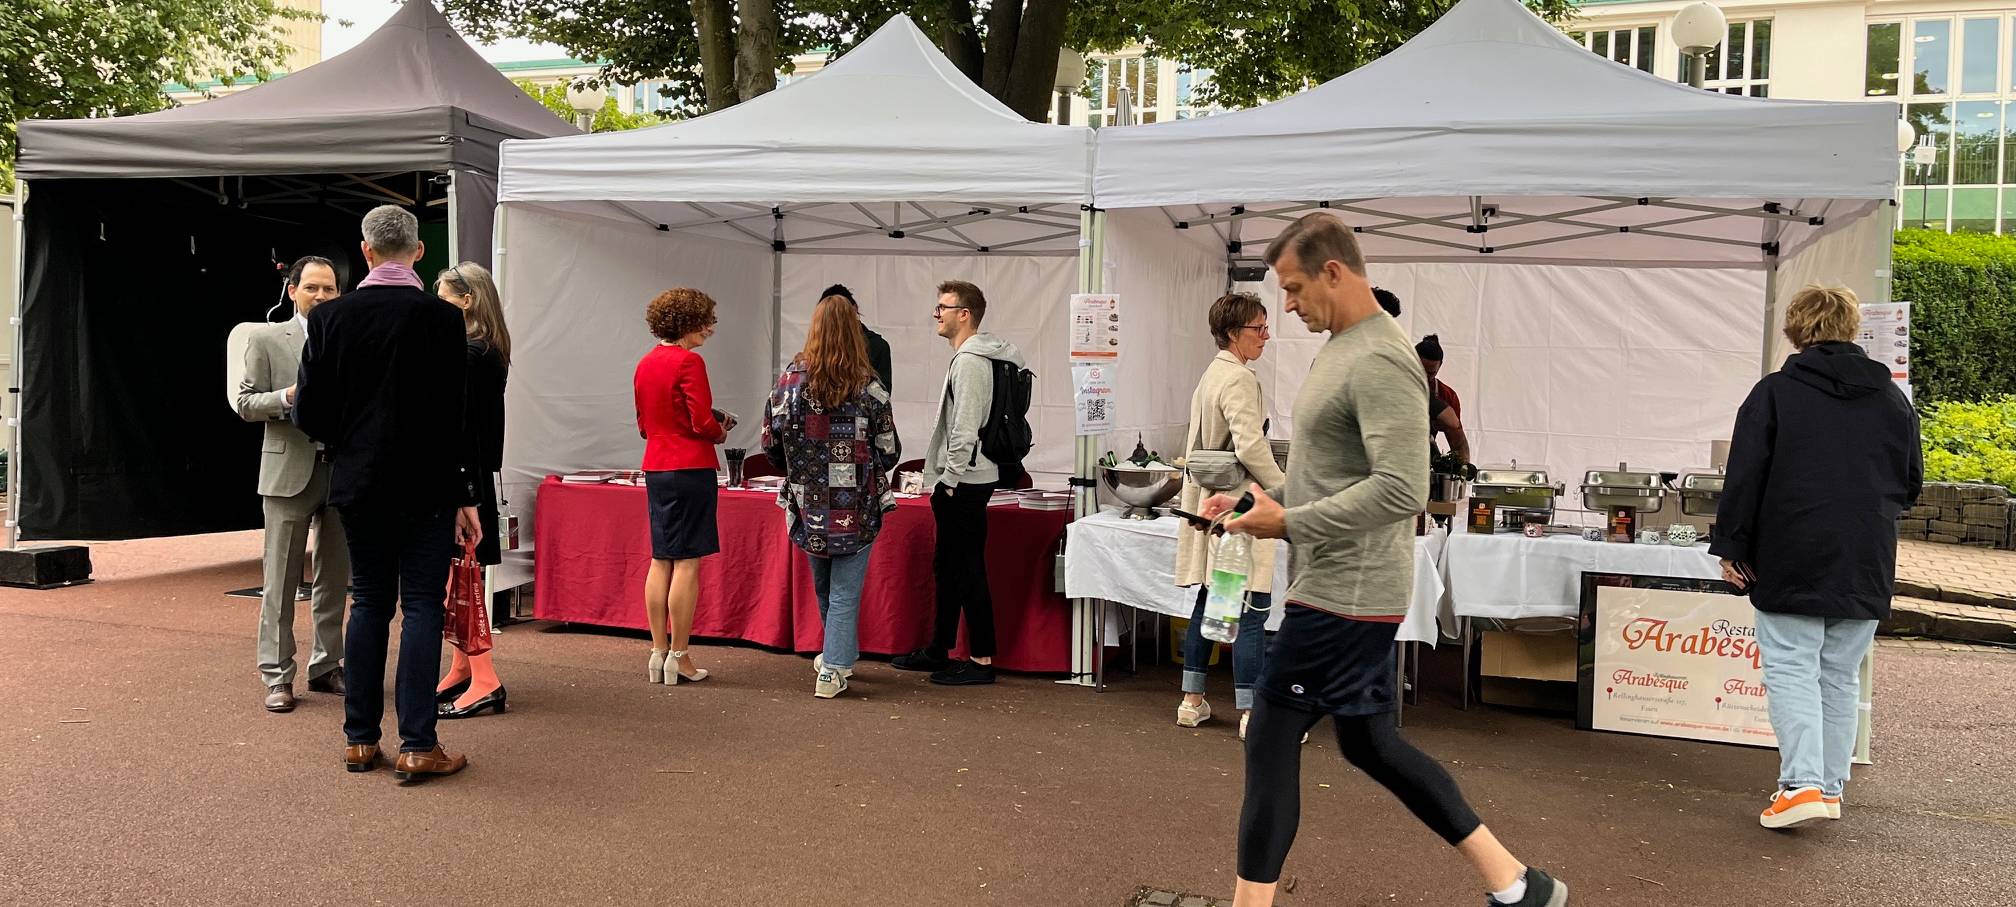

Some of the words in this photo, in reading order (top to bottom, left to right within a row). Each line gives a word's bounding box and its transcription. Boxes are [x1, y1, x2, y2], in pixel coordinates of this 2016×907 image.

[1711, 619, 1756, 637] Resta
[1622, 617, 1762, 670] Arabesq
[1612, 669, 1689, 693] Arabesque
[1723, 678, 1768, 697] Arab
